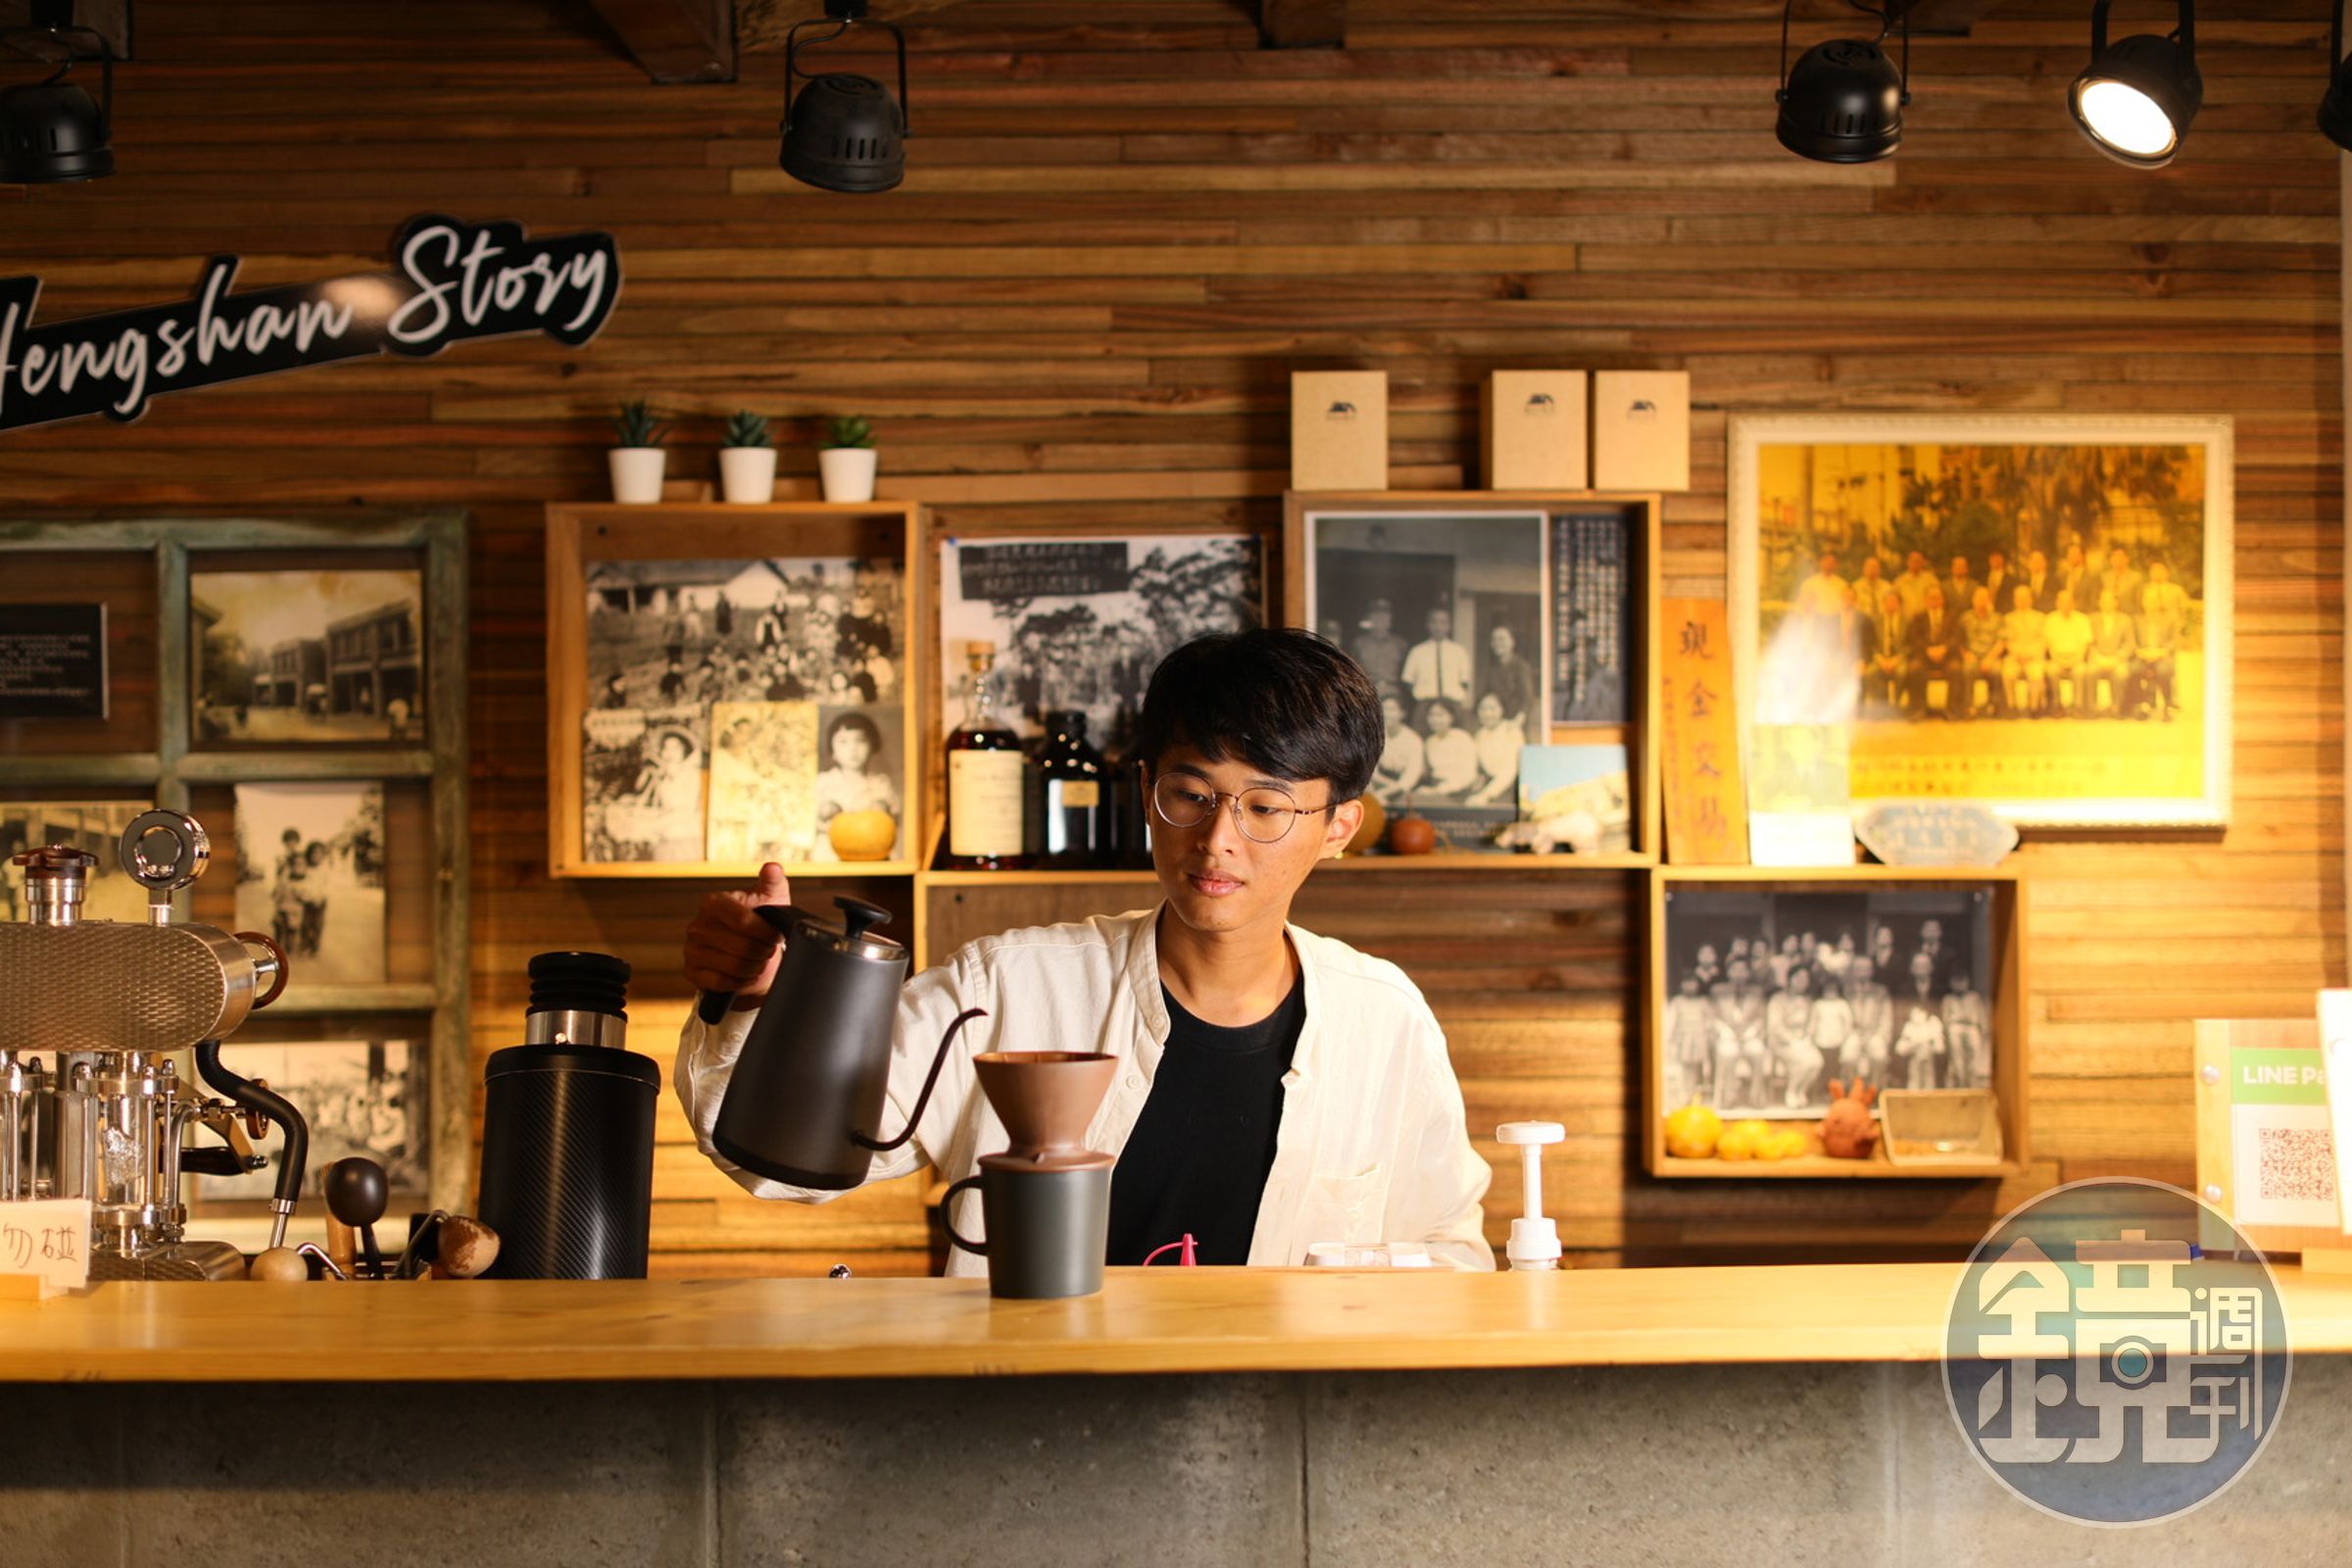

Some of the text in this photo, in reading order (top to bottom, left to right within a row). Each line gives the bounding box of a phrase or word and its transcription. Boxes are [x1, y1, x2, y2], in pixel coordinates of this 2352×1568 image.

[387, 224, 608, 343] Story
[2243, 1064, 2298, 1085] LINE
[3, 1222, 78, 1269] 勿碰
